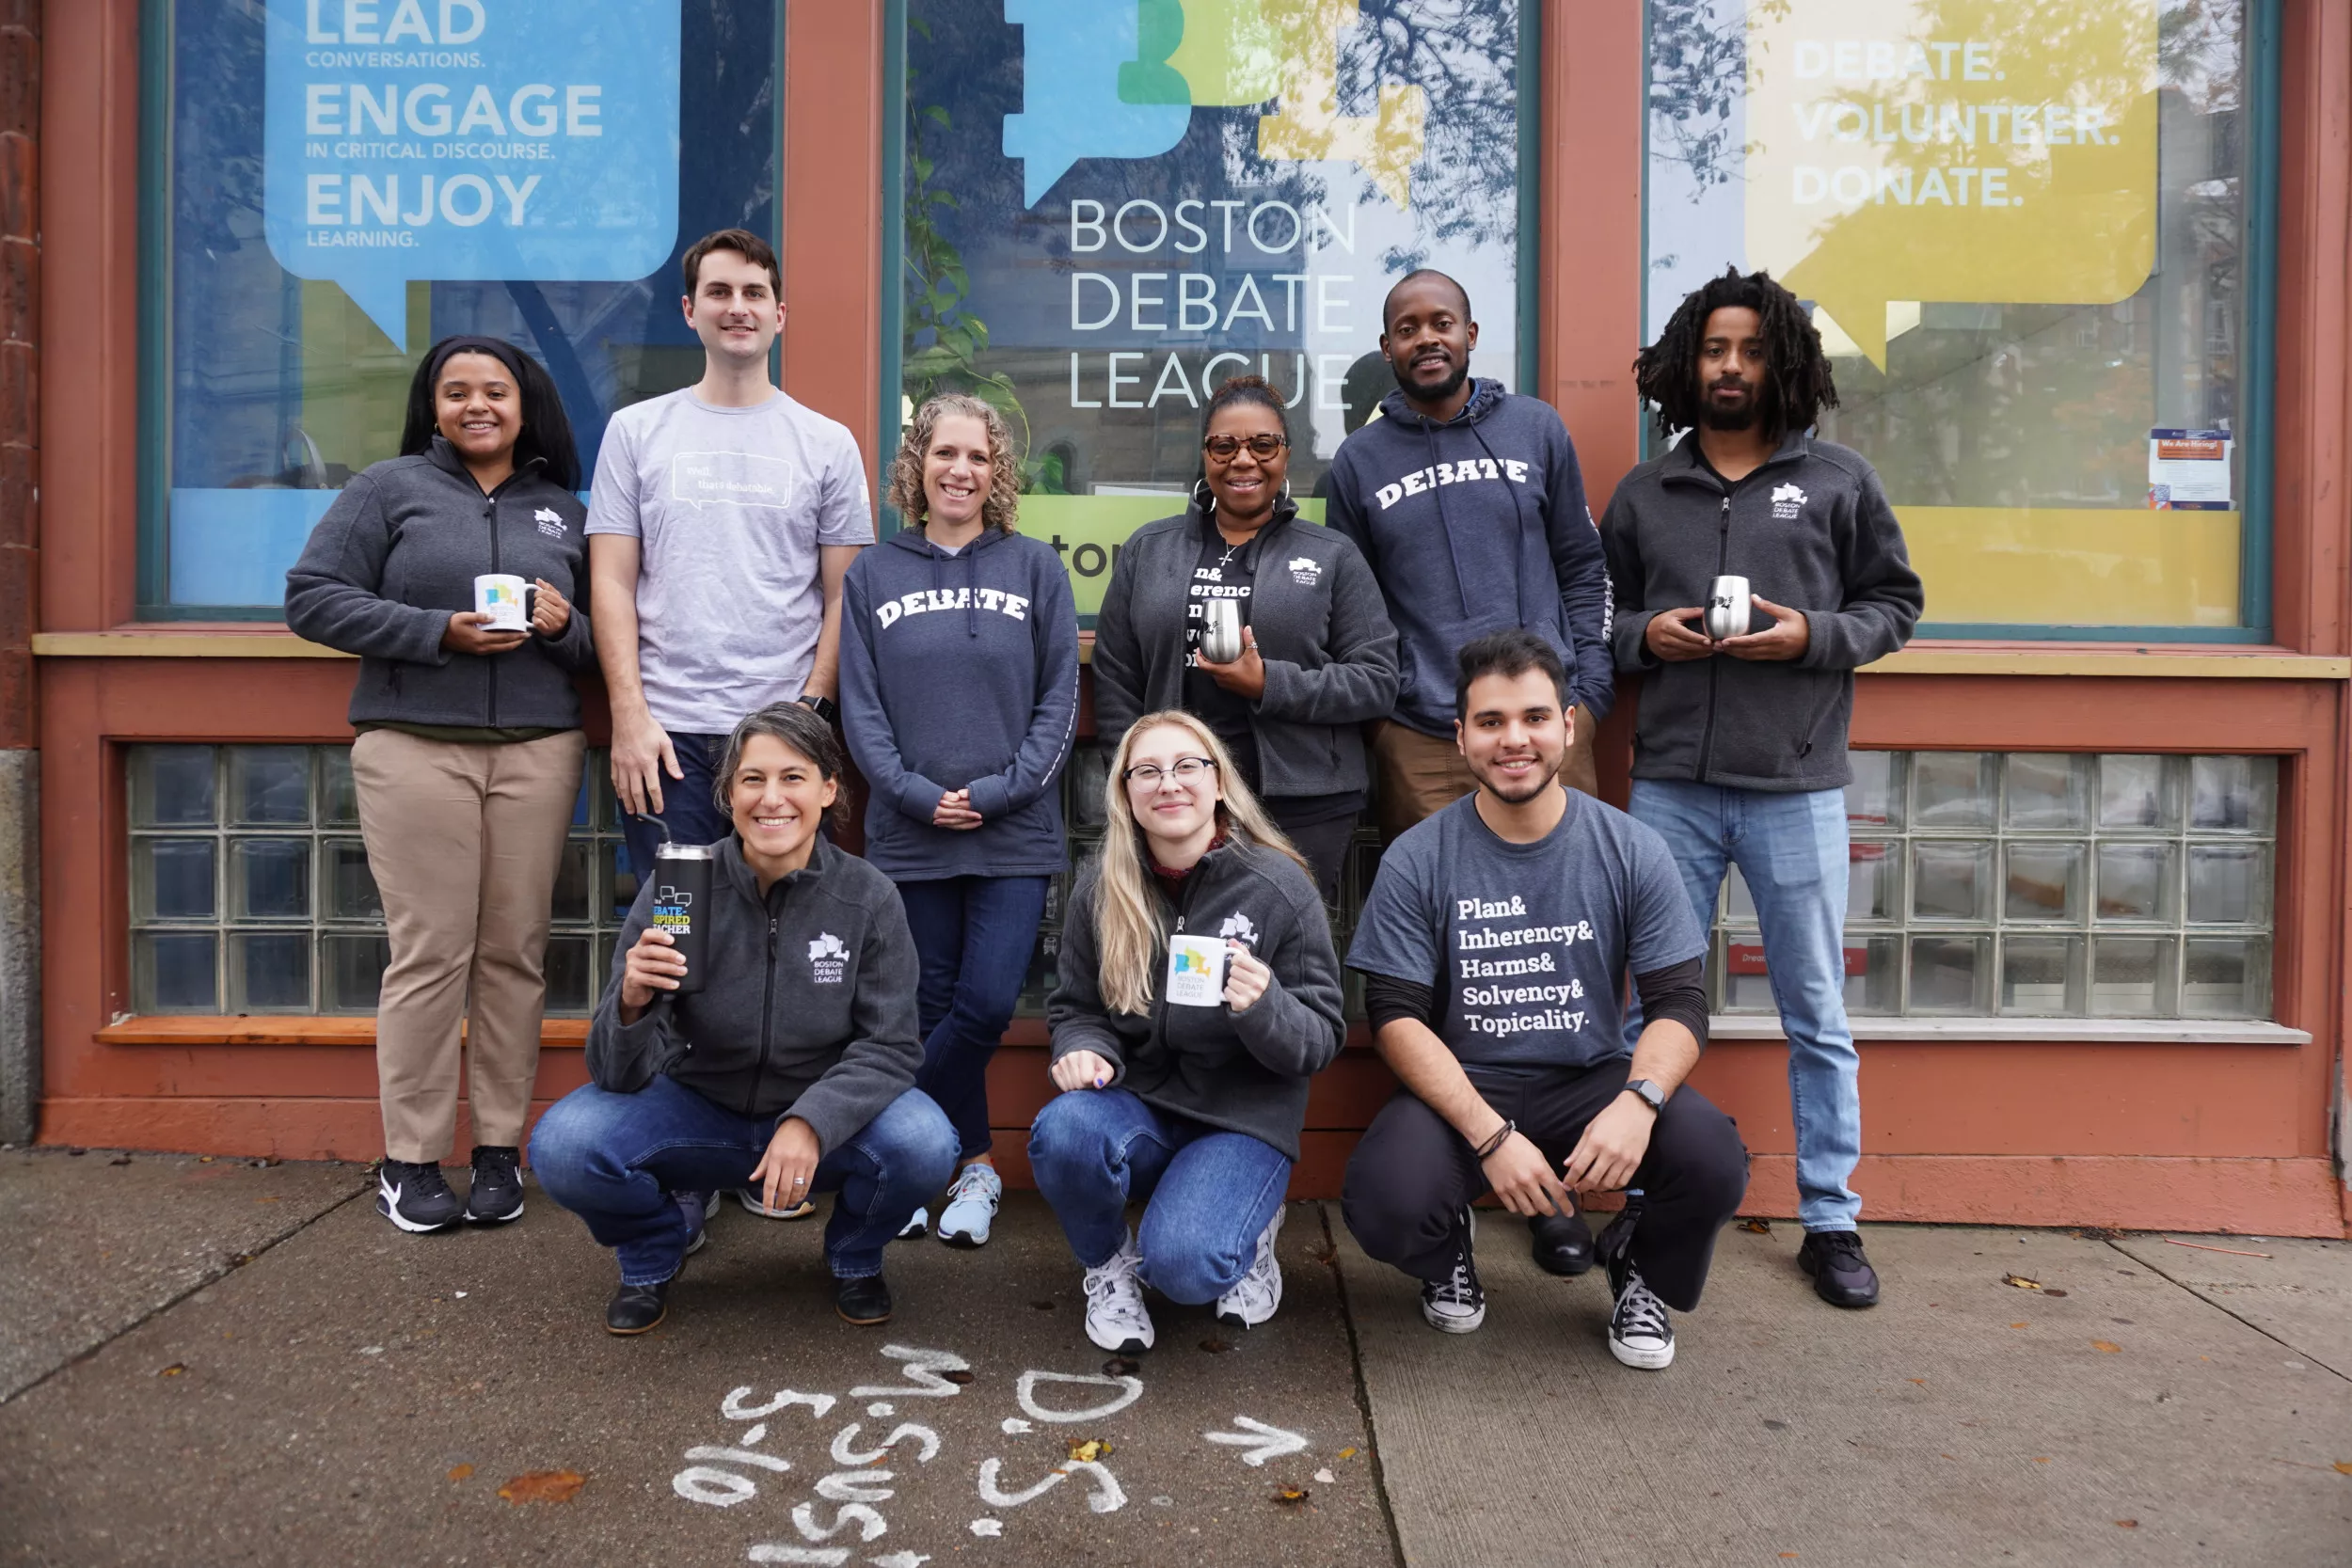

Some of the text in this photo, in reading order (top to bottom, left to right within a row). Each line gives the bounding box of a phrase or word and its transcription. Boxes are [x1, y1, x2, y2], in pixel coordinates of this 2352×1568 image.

[305, 0, 486, 45] LEAD
[305, 51, 486, 69] CONVERSATIONS.
[1793, 40, 2006, 82] DEBATE.
[305, 84, 603, 137] ENGAGE
[1792, 103, 2121, 146] VOLUNTEER.
[306, 142, 556, 160] IN CRITICAL DISCOURSE.
[305, 173, 543, 228] ENJOY
[1792, 164, 2025, 207] DONATE.
[306, 230, 420, 248] LEARNING.
[1071, 198, 1356, 256] BOSTON
[1071, 272, 1355, 333] DEBATE
[2190, 440, 2217, 450] Hiring!
[1375, 458, 1529, 511] DEBATE
[876, 587, 1029, 630] DEBATE
[1457, 895, 1527, 920] Plan&
[1458, 920, 1594, 950] Inherency&
[1460, 952, 1556, 978] Harms&
[1462, 978, 1584, 1006] Solvency&
[1464, 1009, 1590, 1037] Topicality.
